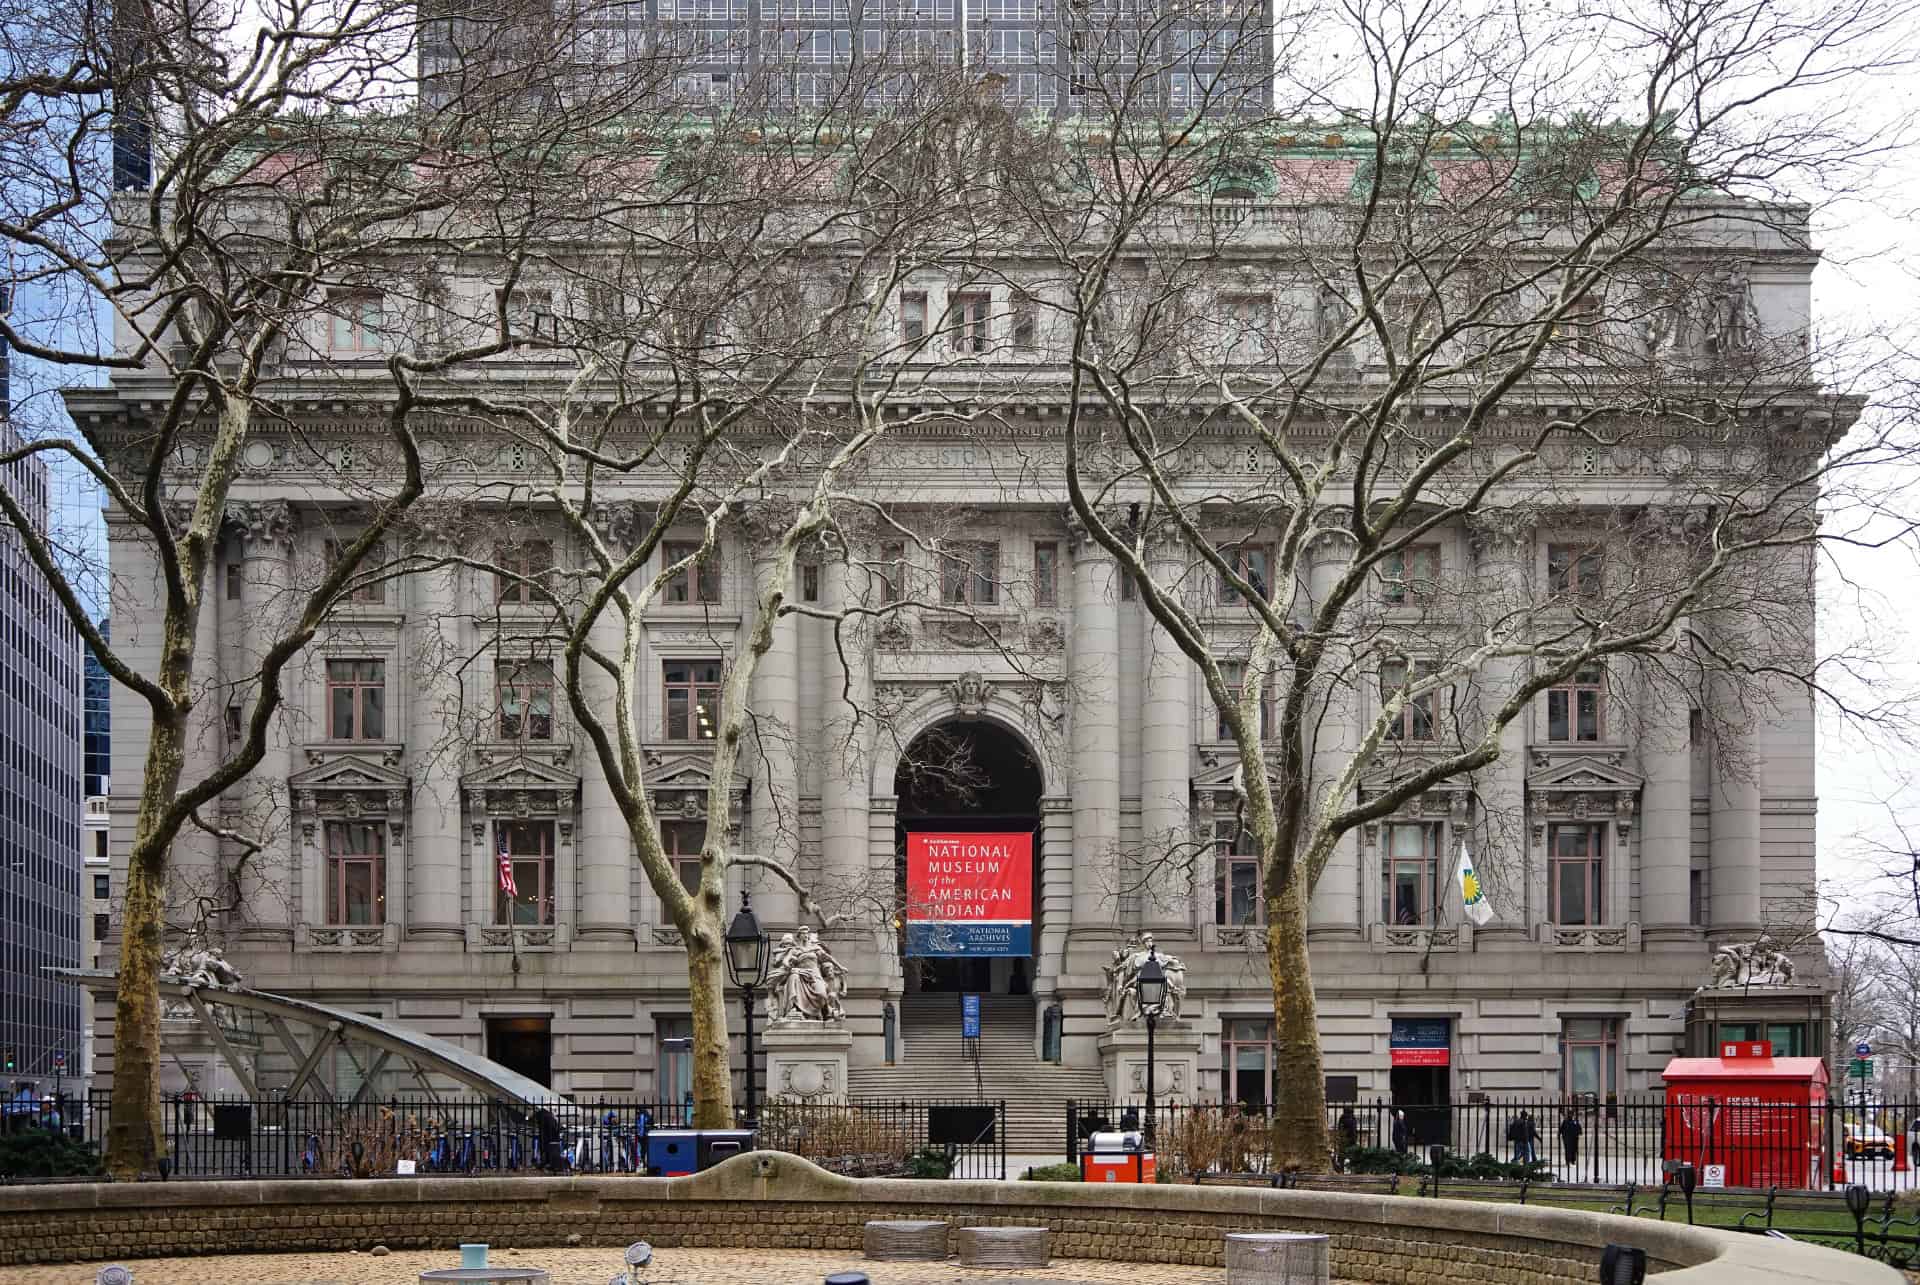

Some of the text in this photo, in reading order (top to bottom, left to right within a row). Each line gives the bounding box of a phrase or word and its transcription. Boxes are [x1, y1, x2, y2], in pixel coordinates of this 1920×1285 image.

[928, 845, 1010, 858] NATIONAL
[928, 861, 999, 873] MUSEUM
[928, 875, 956, 887] of the
[928, 888, 1012, 901] AMERICAN
[928, 904, 985, 916] INDIAN
[968, 934, 1010, 942] ARCHIVES
